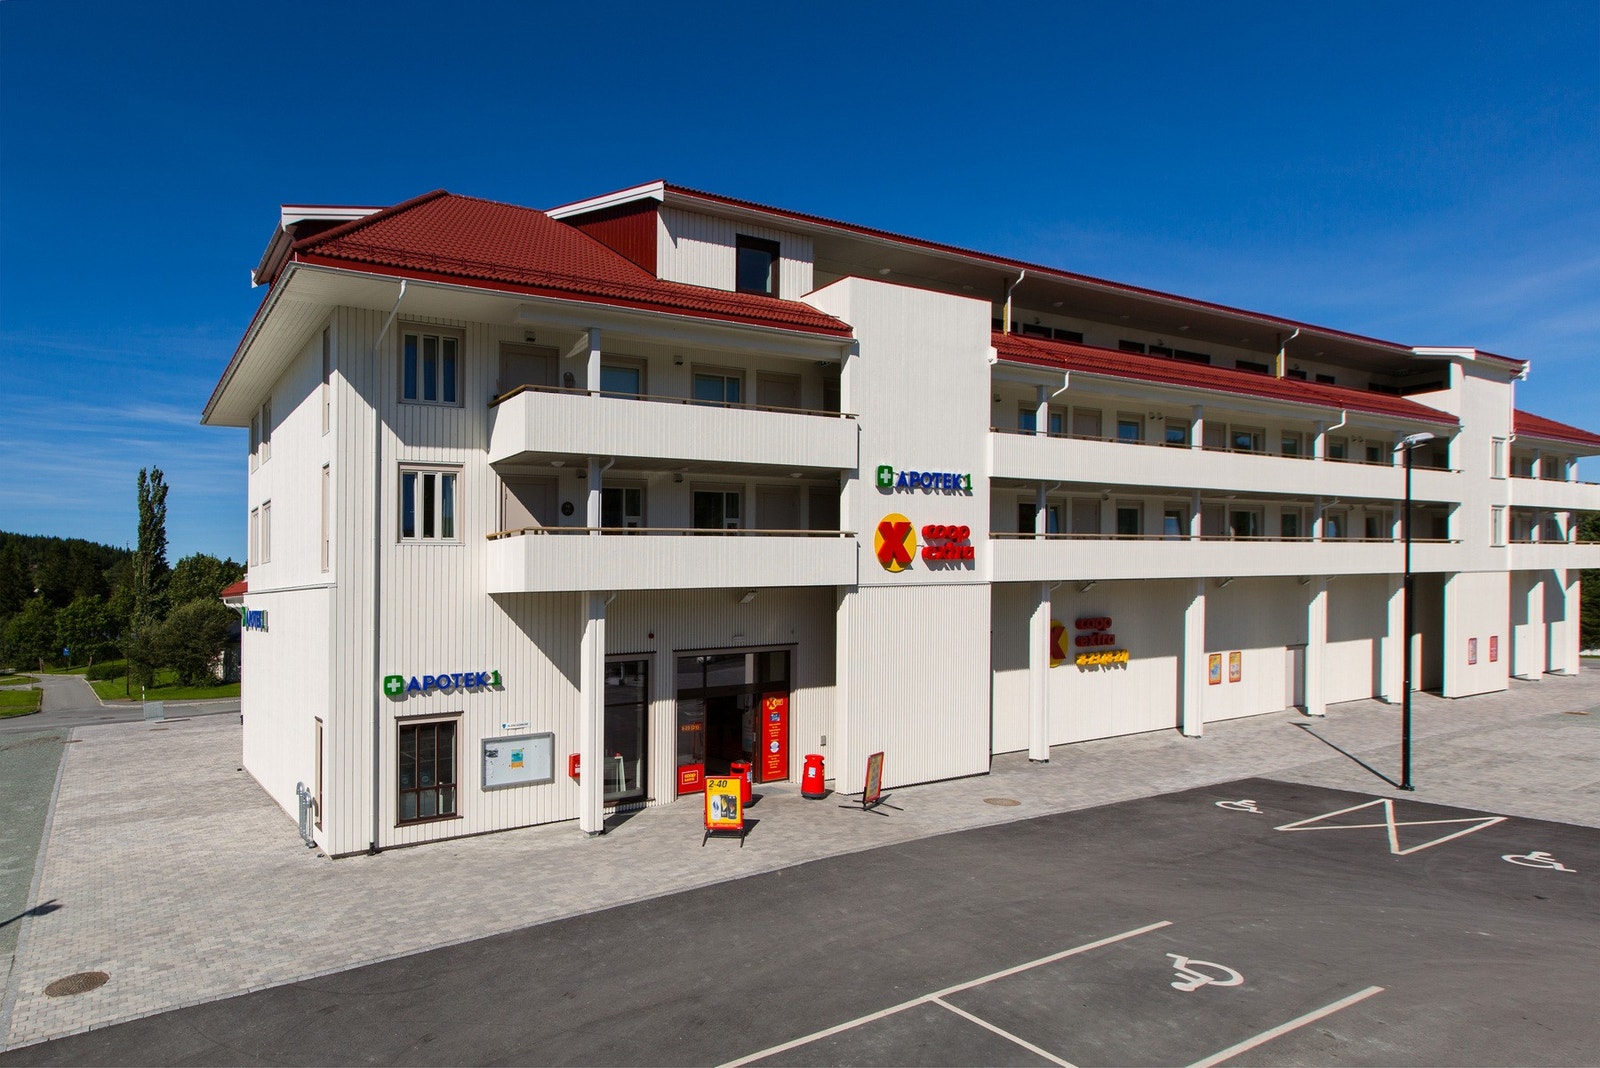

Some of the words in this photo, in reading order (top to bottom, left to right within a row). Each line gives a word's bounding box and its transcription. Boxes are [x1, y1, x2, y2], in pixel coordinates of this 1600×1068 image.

[922, 525, 970, 542] coop
[922, 542, 974, 560] extra
[1075, 616, 1112, 631] coop
[1075, 632, 1115, 647] extra
